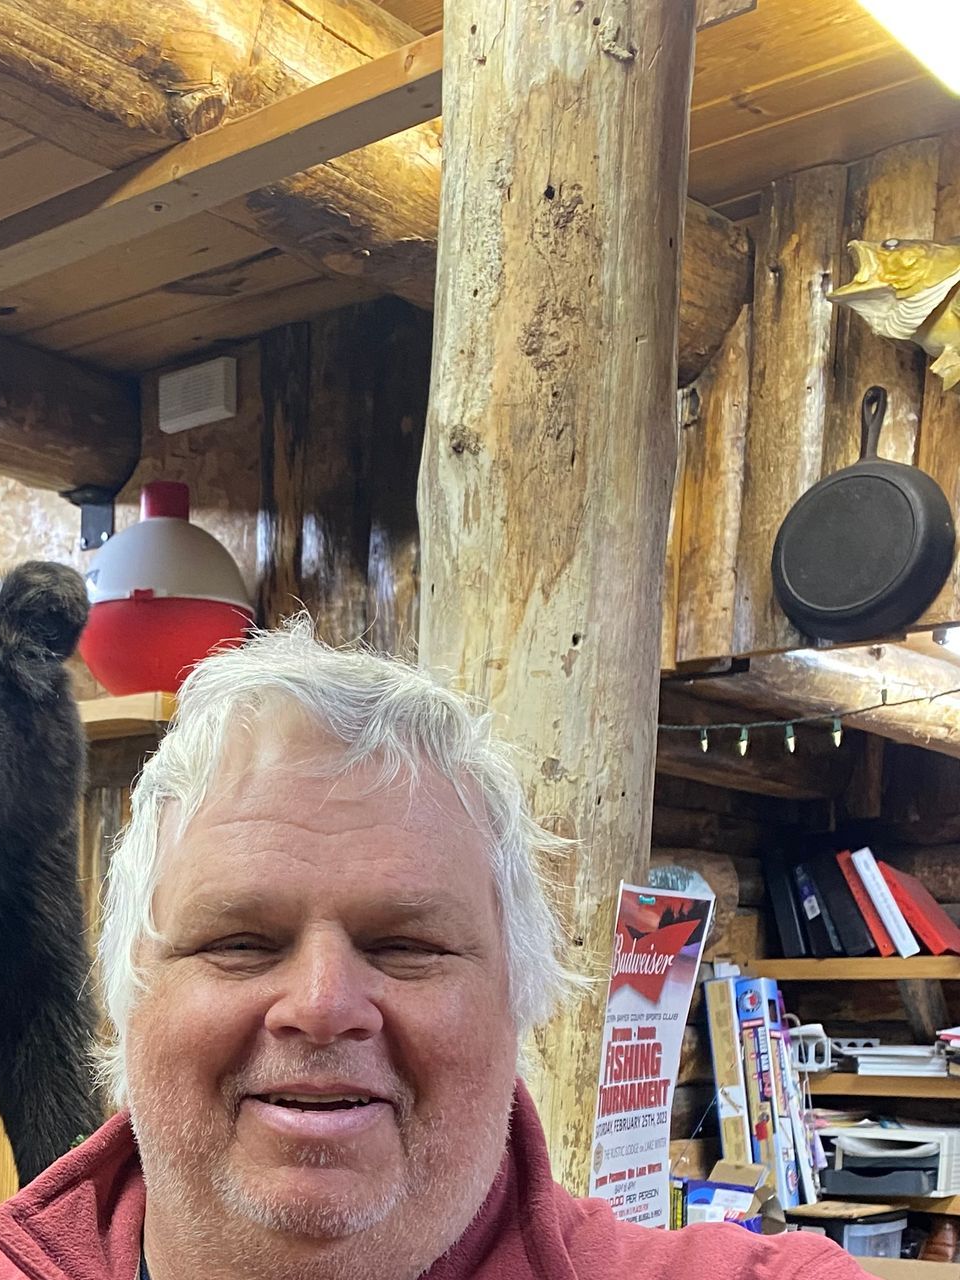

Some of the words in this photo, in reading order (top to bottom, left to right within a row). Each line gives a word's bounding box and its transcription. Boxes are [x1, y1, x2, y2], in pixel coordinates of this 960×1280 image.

[613, 932, 674, 976] Budweiser
[662, 1012, 679, 1021] CLUB
[604, 1041, 662, 1085] FISHING
[598, 1078, 671, 1119] TOURNAMENT
[614, 1114, 640, 1132] FEBRUARY
[626, 1193, 637, 1204] PER
[638, 1188, 659, 1201] PERSON
